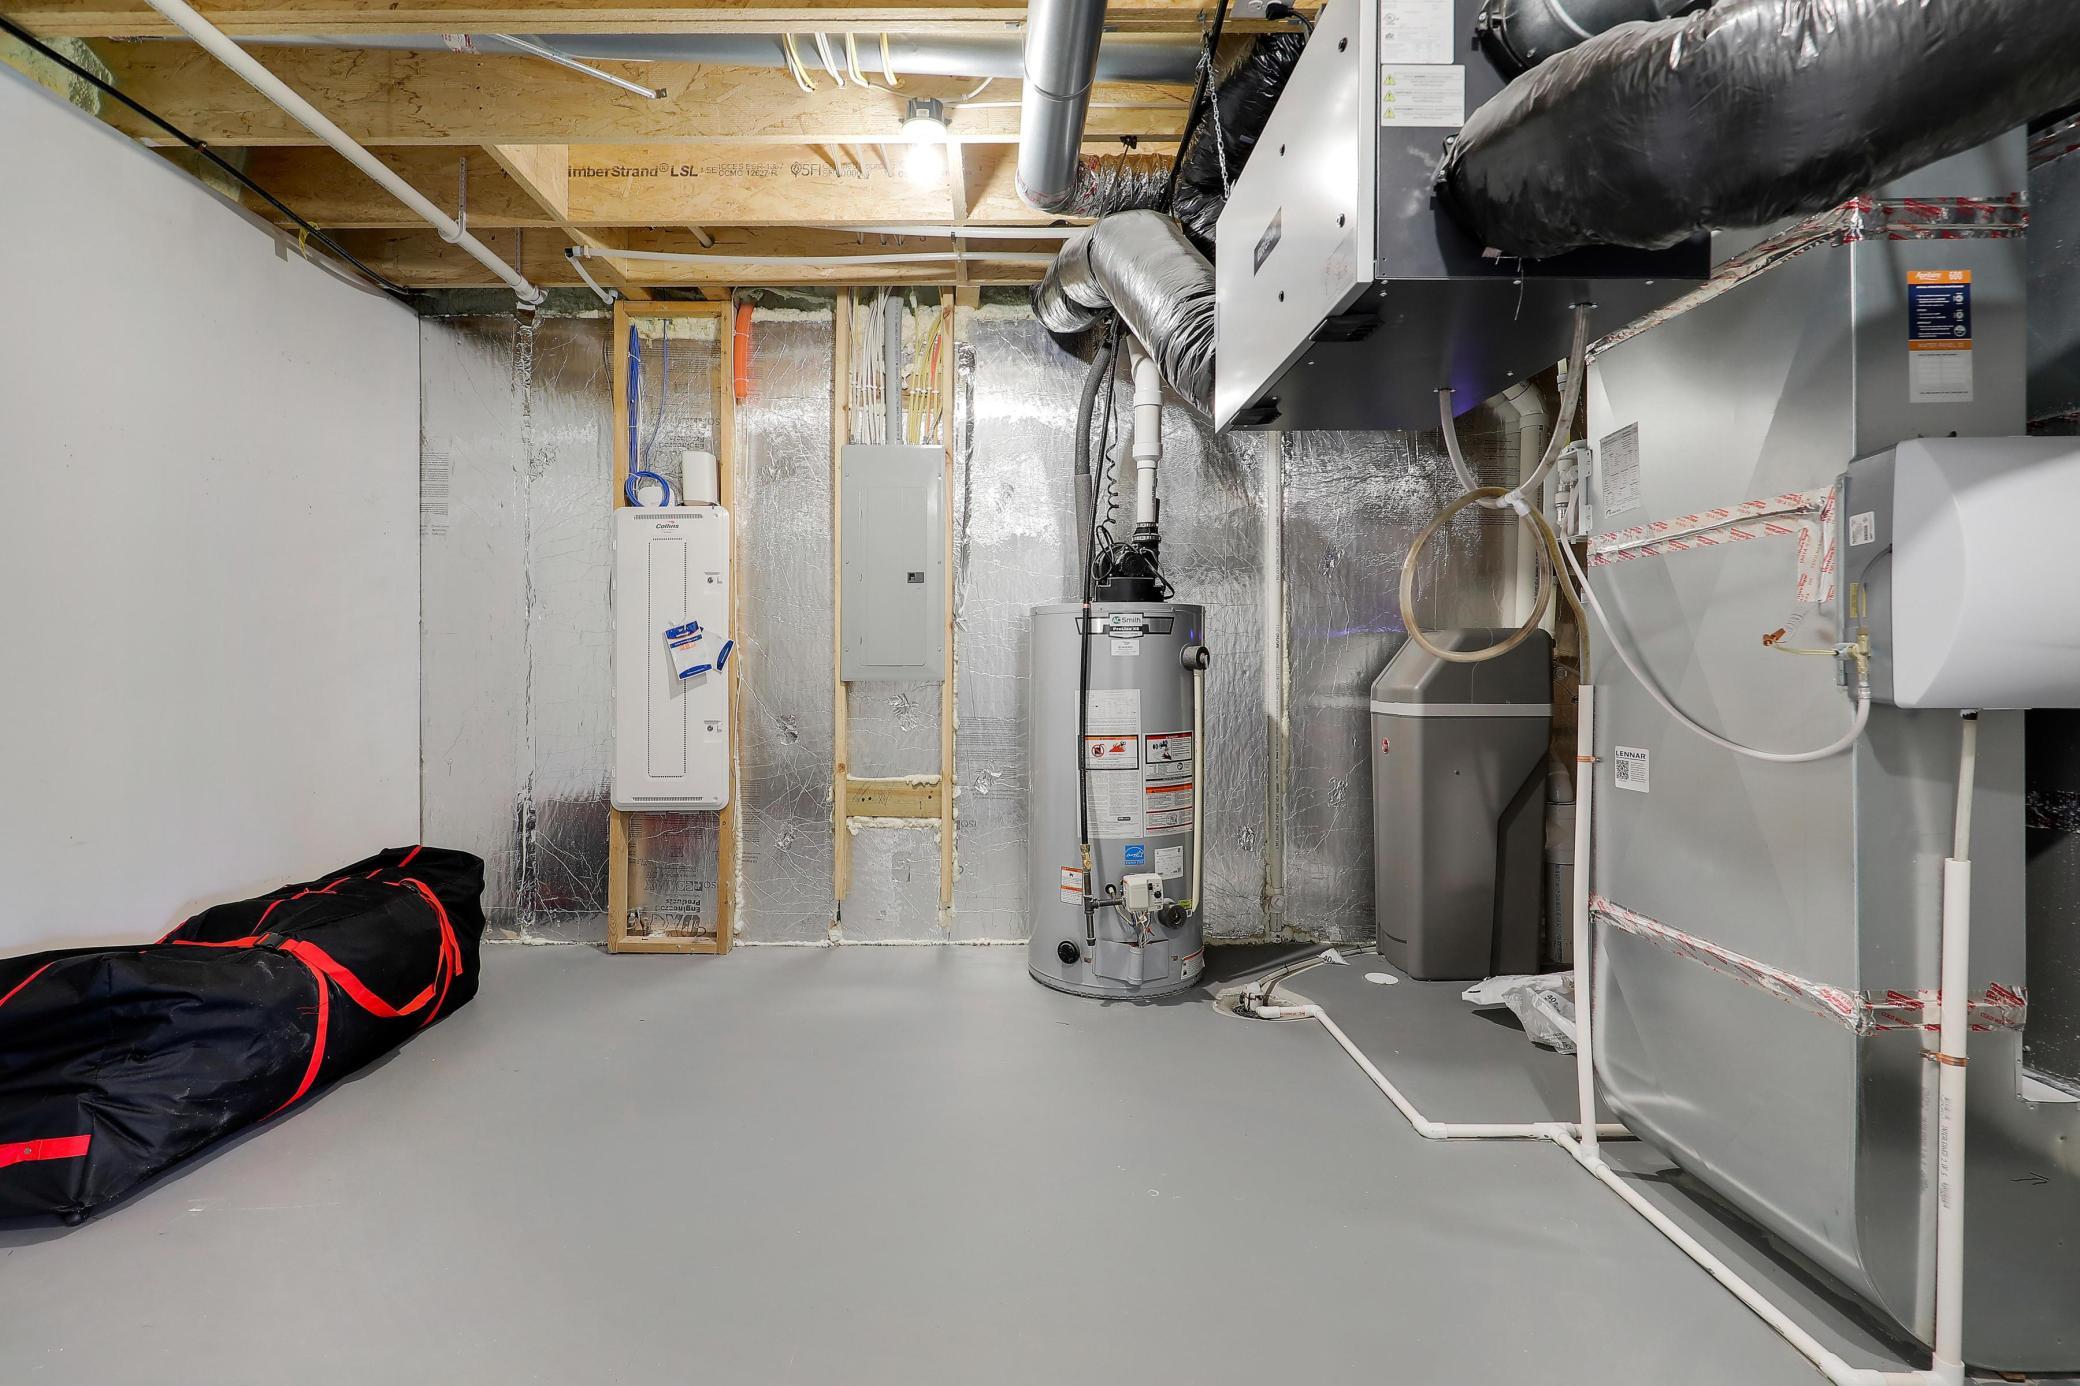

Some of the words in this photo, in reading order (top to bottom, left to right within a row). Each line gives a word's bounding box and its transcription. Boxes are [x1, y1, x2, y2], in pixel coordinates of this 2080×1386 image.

[670, 165, 698, 177] LSL
[801, 163, 821, 176] SFI
[1615, 750, 1646, 760] LENNAR
